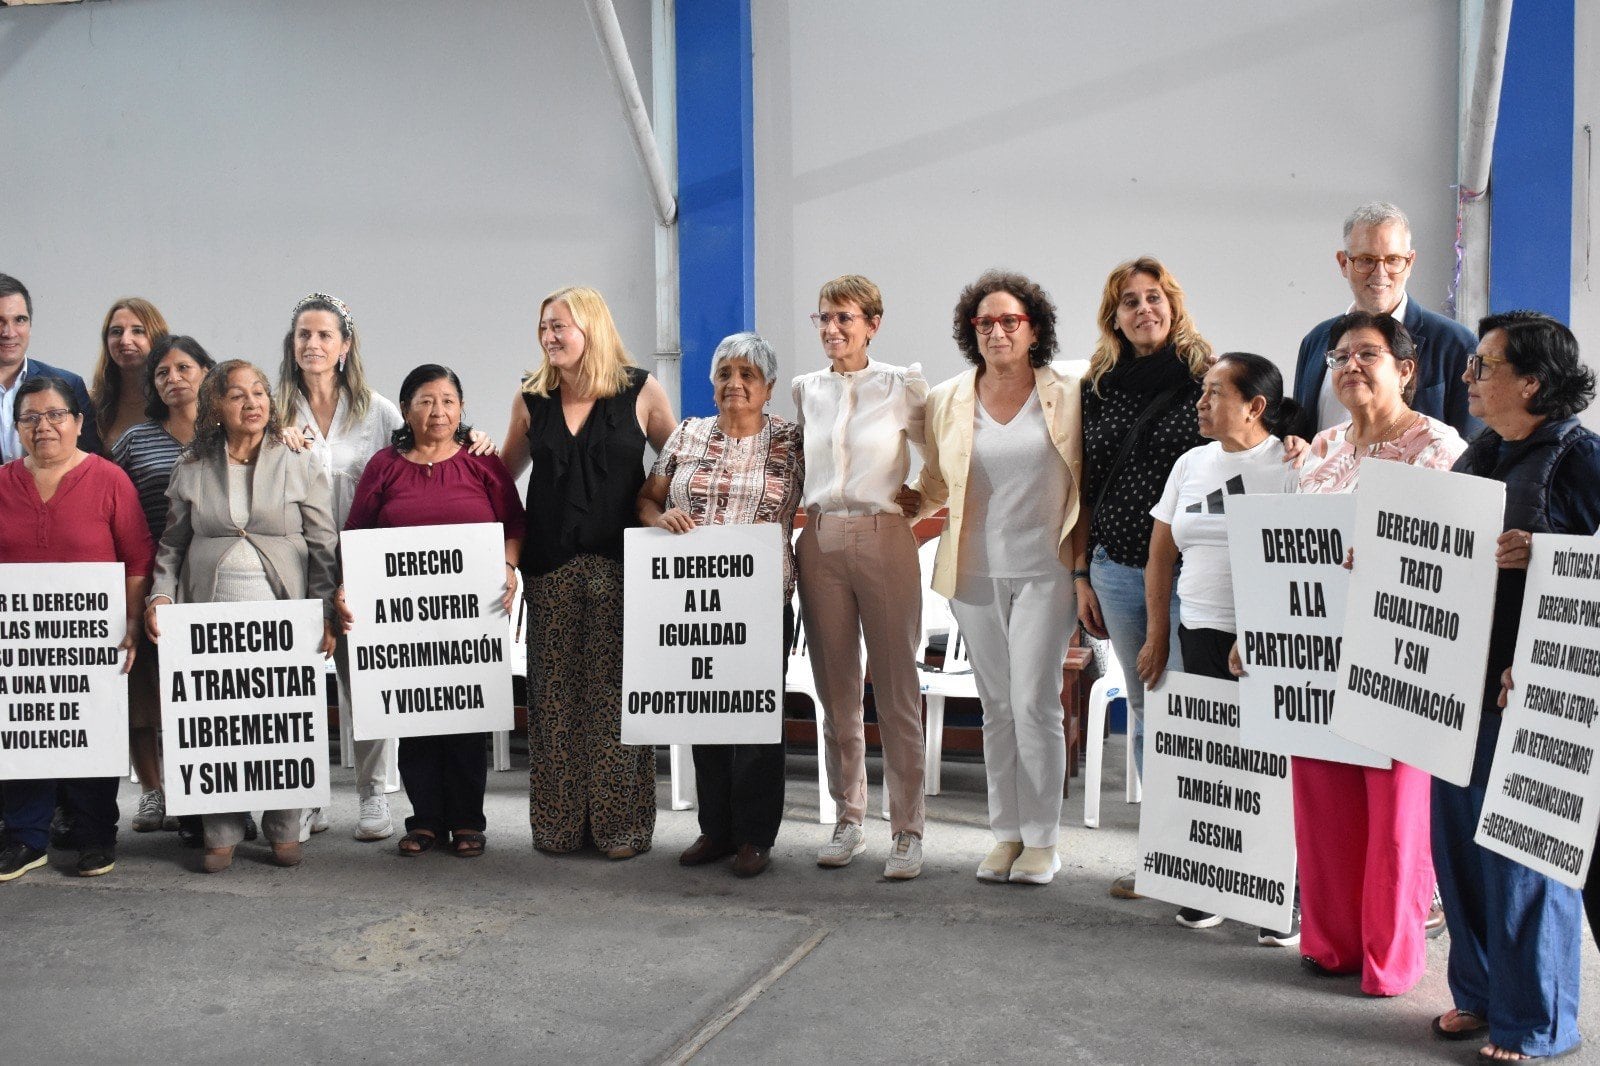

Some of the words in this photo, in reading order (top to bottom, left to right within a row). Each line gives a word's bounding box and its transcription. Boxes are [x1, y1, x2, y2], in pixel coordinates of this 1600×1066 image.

[1262, 528, 1343, 565] DERECHO
[1377, 511, 1439, 550] DERECHO
[1441, 526, 1450, 553] A
[1454, 528, 1474, 559] UN
[386, 549, 463, 577] DERECHO
[652, 557, 669, 579] EL
[674, 554, 753, 578] DERECHO
[1401, 557, 1442, 593] TRATO
[1552, 547, 1594, 579] POLÍTICAS
[12, 594, 28, 611] EL
[33, 593, 108, 611] DERECHO
[376, 599, 386, 623] A
[390, 597, 413, 622] NO
[418, 594, 479, 621] SUFRIR
[685, 590, 696, 612] A
[701, 589, 721, 611] LA
[1290, 582, 1302, 616] A
[1304, 582, 1326, 617] LA
[1537, 595, 1579, 625] DERECHOS
[1, 621, 30, 639] LAS
[35, 620, 108, 638] MUJERES
[1374, 591, 1459, 642] IGUALITARIO
[191, 620, 293, 654] DERECHO
[660, 623, 746, 646] IGUALDAD
[0, 649, 13, 667] U
[19, 647, 119, 666] DIVERSIDAD
[357, 634, 502, 670] DISCRIMINACIÓN
[692, 657, 713, 679] DE
[1394, 638, 1403, 665] Y
[1405, 641, 1429, 674] SIN
[1531, 639, 1560, 668] RIESGO
[1559, 644, 1567, 670] A
[13, 676, 46, 694] UNA
[50, 675, 90, 693] VIDA
[172, 671, 187, 702] A
[191, 666, 315, 701] TRANSITAR
[381, 690, 391, 714] Y
[395, 685, 484, 713] VIOLENCIA
[1348, 664, 1465, 731] DISCRIMINACIÓN
[9, 703, 55, 721] LIBRE
[60, 702, 79, 720] DE
[629, 690, 775, 714] OPORTUNIDADES
[1168, 694, 1182, 717] LA
[1524, 683, 1566, 717] PERSONAS
[1564, 693, 1598, 728] LGTBIQ+
[1, 730, 88, 749] VIOLENCIA
[179, 712, 314, 748] LIBREMENTE
[1156, 731, 1202, 761] CRIMEN
[1206, 741, 1286, 778] ORGANIZADO
[1512, 728, 1529, 754] ¡NO
[1527, 731, 1594, 775] RETROCEDEMOS!
[180, 764, 193, 795] Y
[200, 762, 237, 794] SIN
[244, 758, 314, 791] MIEDO
[1178, 776, 1231, 809] TAMBIÉN
[1235, 788, 1260, 815] NOS
[1502, 772, 1584, 823] #JUSTICIAINCLUSIVA
[1190, 820, 1242, 853] ASESINA
[1481, 812, 1584, 876] #DERECHOSSINRETROCESO
[1144, 851, 1284, 906] #VIVASNOSQUEREMOS
